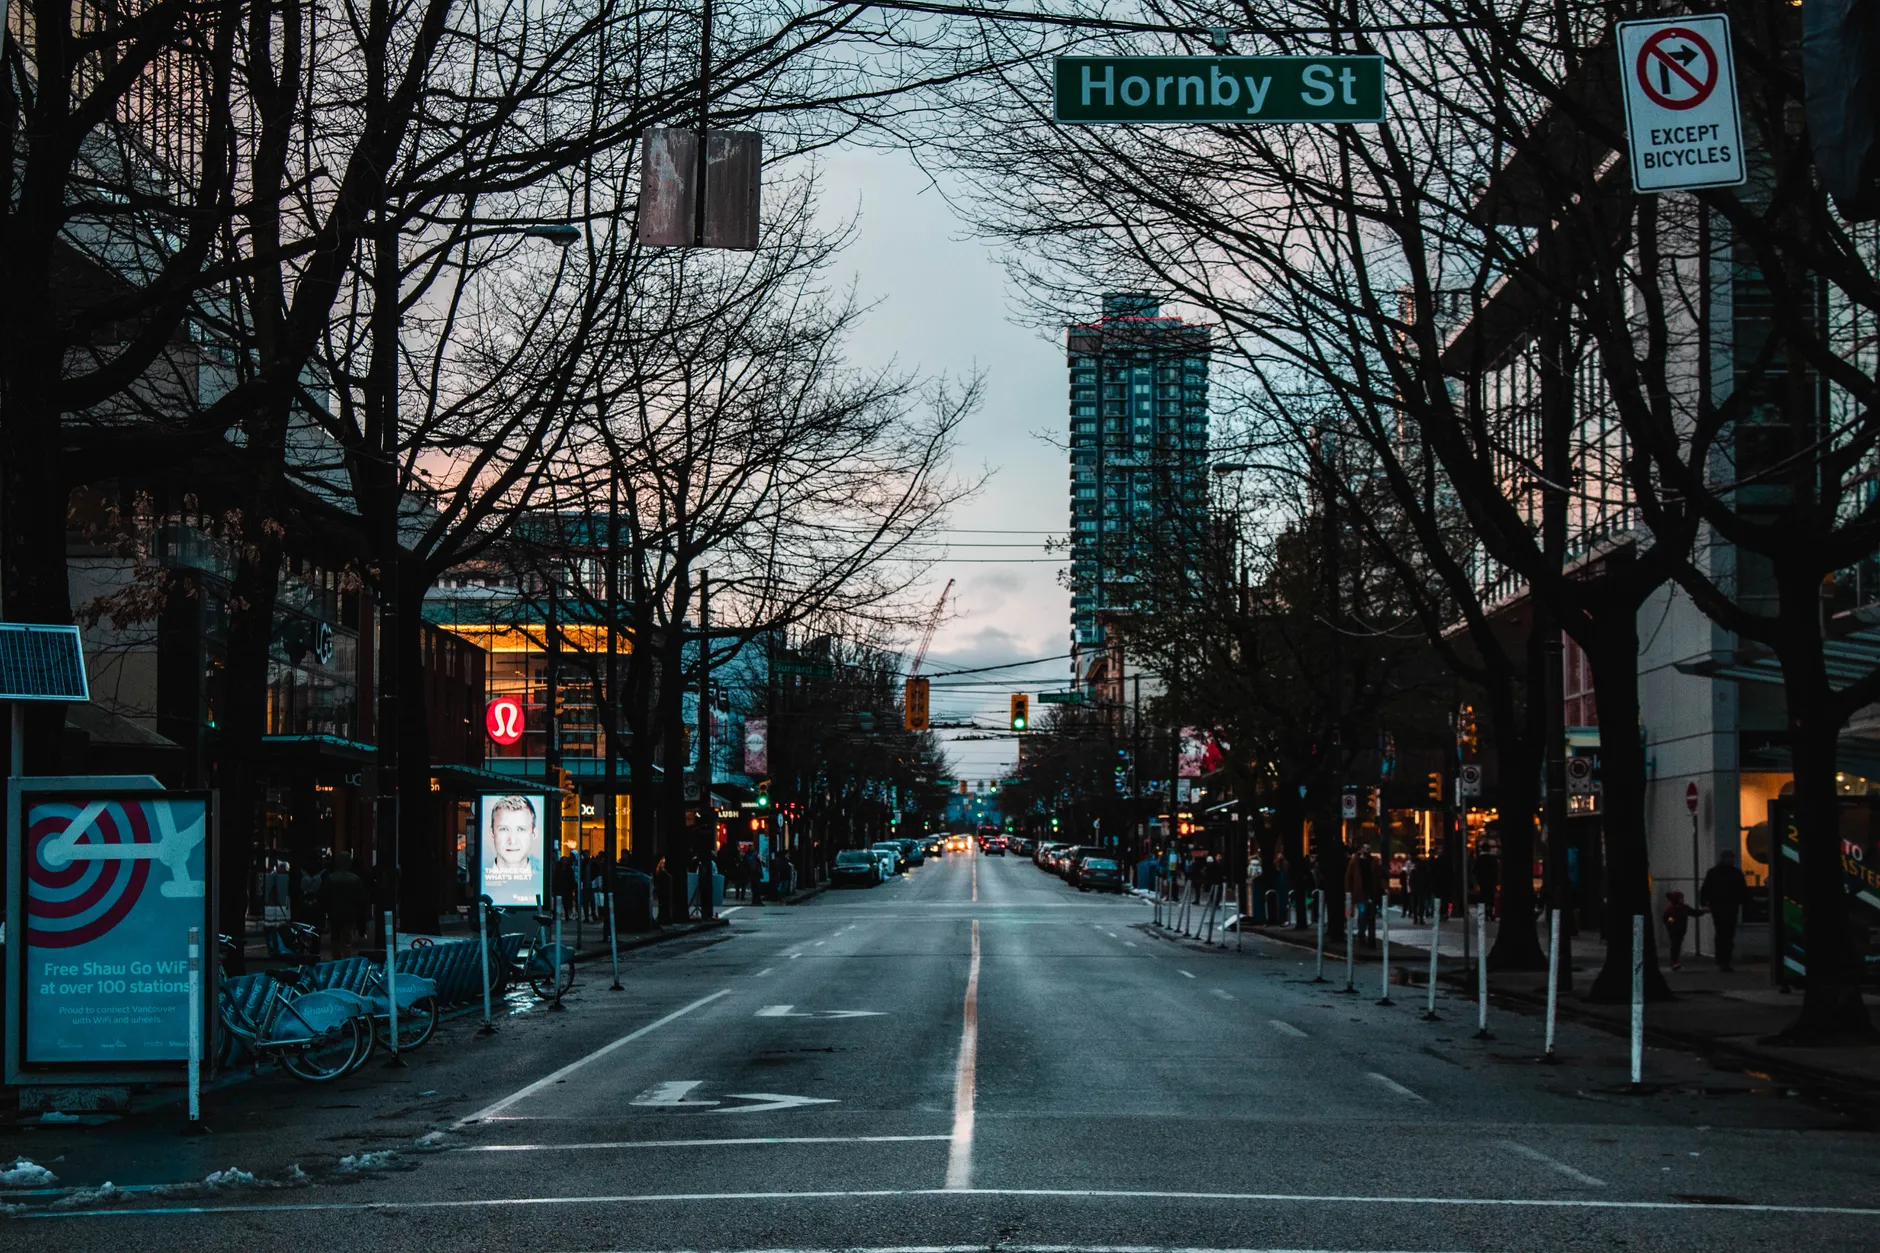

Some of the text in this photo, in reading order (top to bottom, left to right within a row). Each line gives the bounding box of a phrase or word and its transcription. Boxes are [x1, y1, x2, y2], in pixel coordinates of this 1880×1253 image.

[1081, 64, 1357, 115] Hornby St
[1650, 124, 1720, 146] EXCEPT
[1643, 146, 1732, 169] BICYCLES
[717, 810, 740, 818] LUSH
[1842, 838, 1863, 861] TO
[44, 960, 188, 976] Free Shaw Go WiF
[40, 979, 190, 995] at over 100 stations
[59, 1005, 176, 1014] Proud to connect Vancouver
[72, 1016, 91, 1025] with
[92, 1016, 112, 1024] WiFi
[113, 1016, 129, 1024] and
